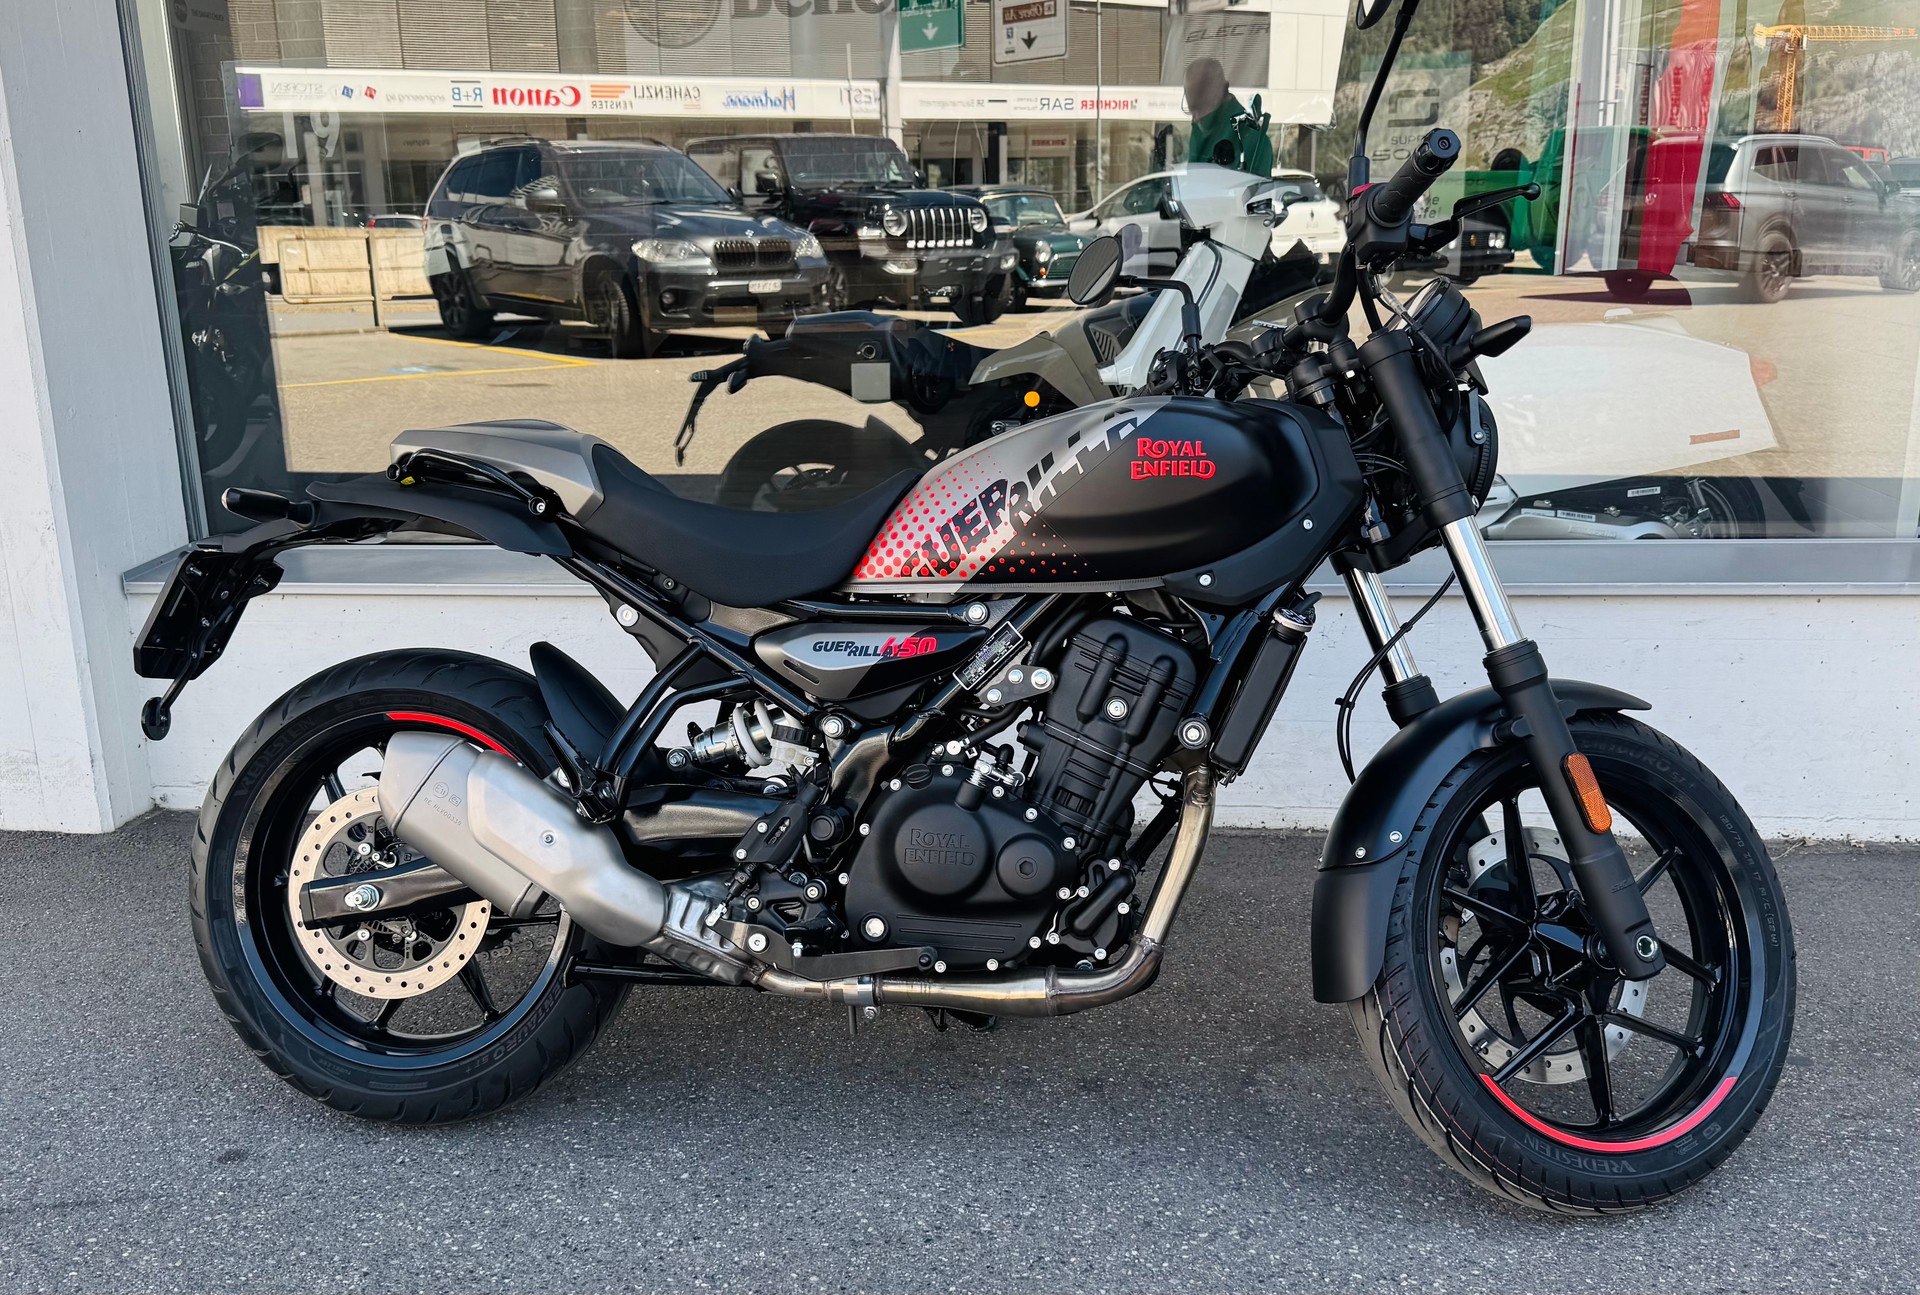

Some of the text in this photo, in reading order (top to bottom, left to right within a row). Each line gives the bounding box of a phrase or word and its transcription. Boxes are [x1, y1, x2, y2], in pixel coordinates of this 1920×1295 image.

[1136, 437, 1207, 459] ROYAL
[1130, 460, 1216, 480] ENFIELD
[812, 640, 893, 658] GUERRILLA
[909, 828, 970, 849] ROYAL
[904, 848, 977, 867] ENFIELD
[1523, 1134, 1638, 1174] VREDESTEIN
